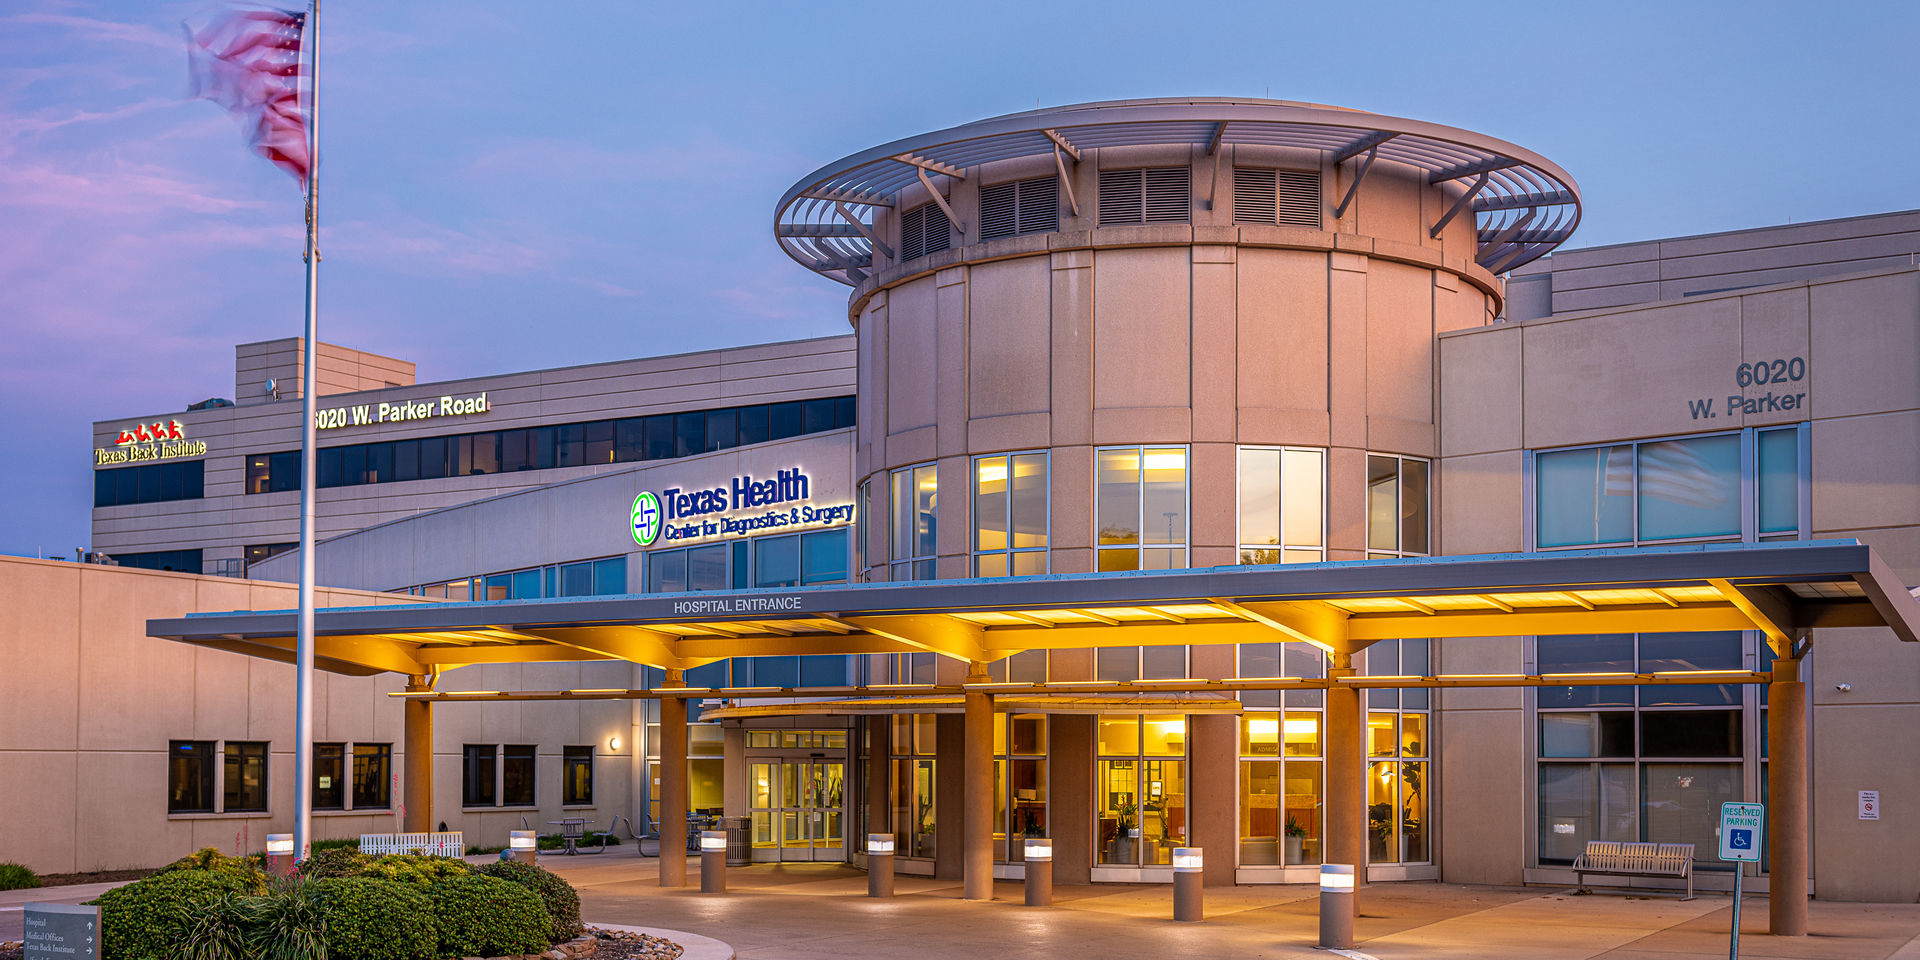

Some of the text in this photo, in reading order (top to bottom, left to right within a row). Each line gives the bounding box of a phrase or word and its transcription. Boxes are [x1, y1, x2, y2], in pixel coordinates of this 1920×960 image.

[1736, 357, 1805, 387] 6020
[352, 405, 373, 425] W.
[378, 400, 435, 423] Parker
[440, 392, 488, 416] Road
[1688, 392, 1806, 420] W. Parker
[94, 440, 207, 465] Texas Back Institute
[663, 467, 809, 520] Texas Health
[664, 504, 855, 541] Center for Diagnostics & Surgery
[674, 597, 802, 614] HOSPITAL ENTRANCE
[1725, 807, 1760, 817] RESERVED
[1726, 817, 1758, 827] PARKING
[26, 917, 46, 928] Hospital
[26, 931, 64, 942] Medical Offices
[26, 941, 75, 953] Texas Back Institute
